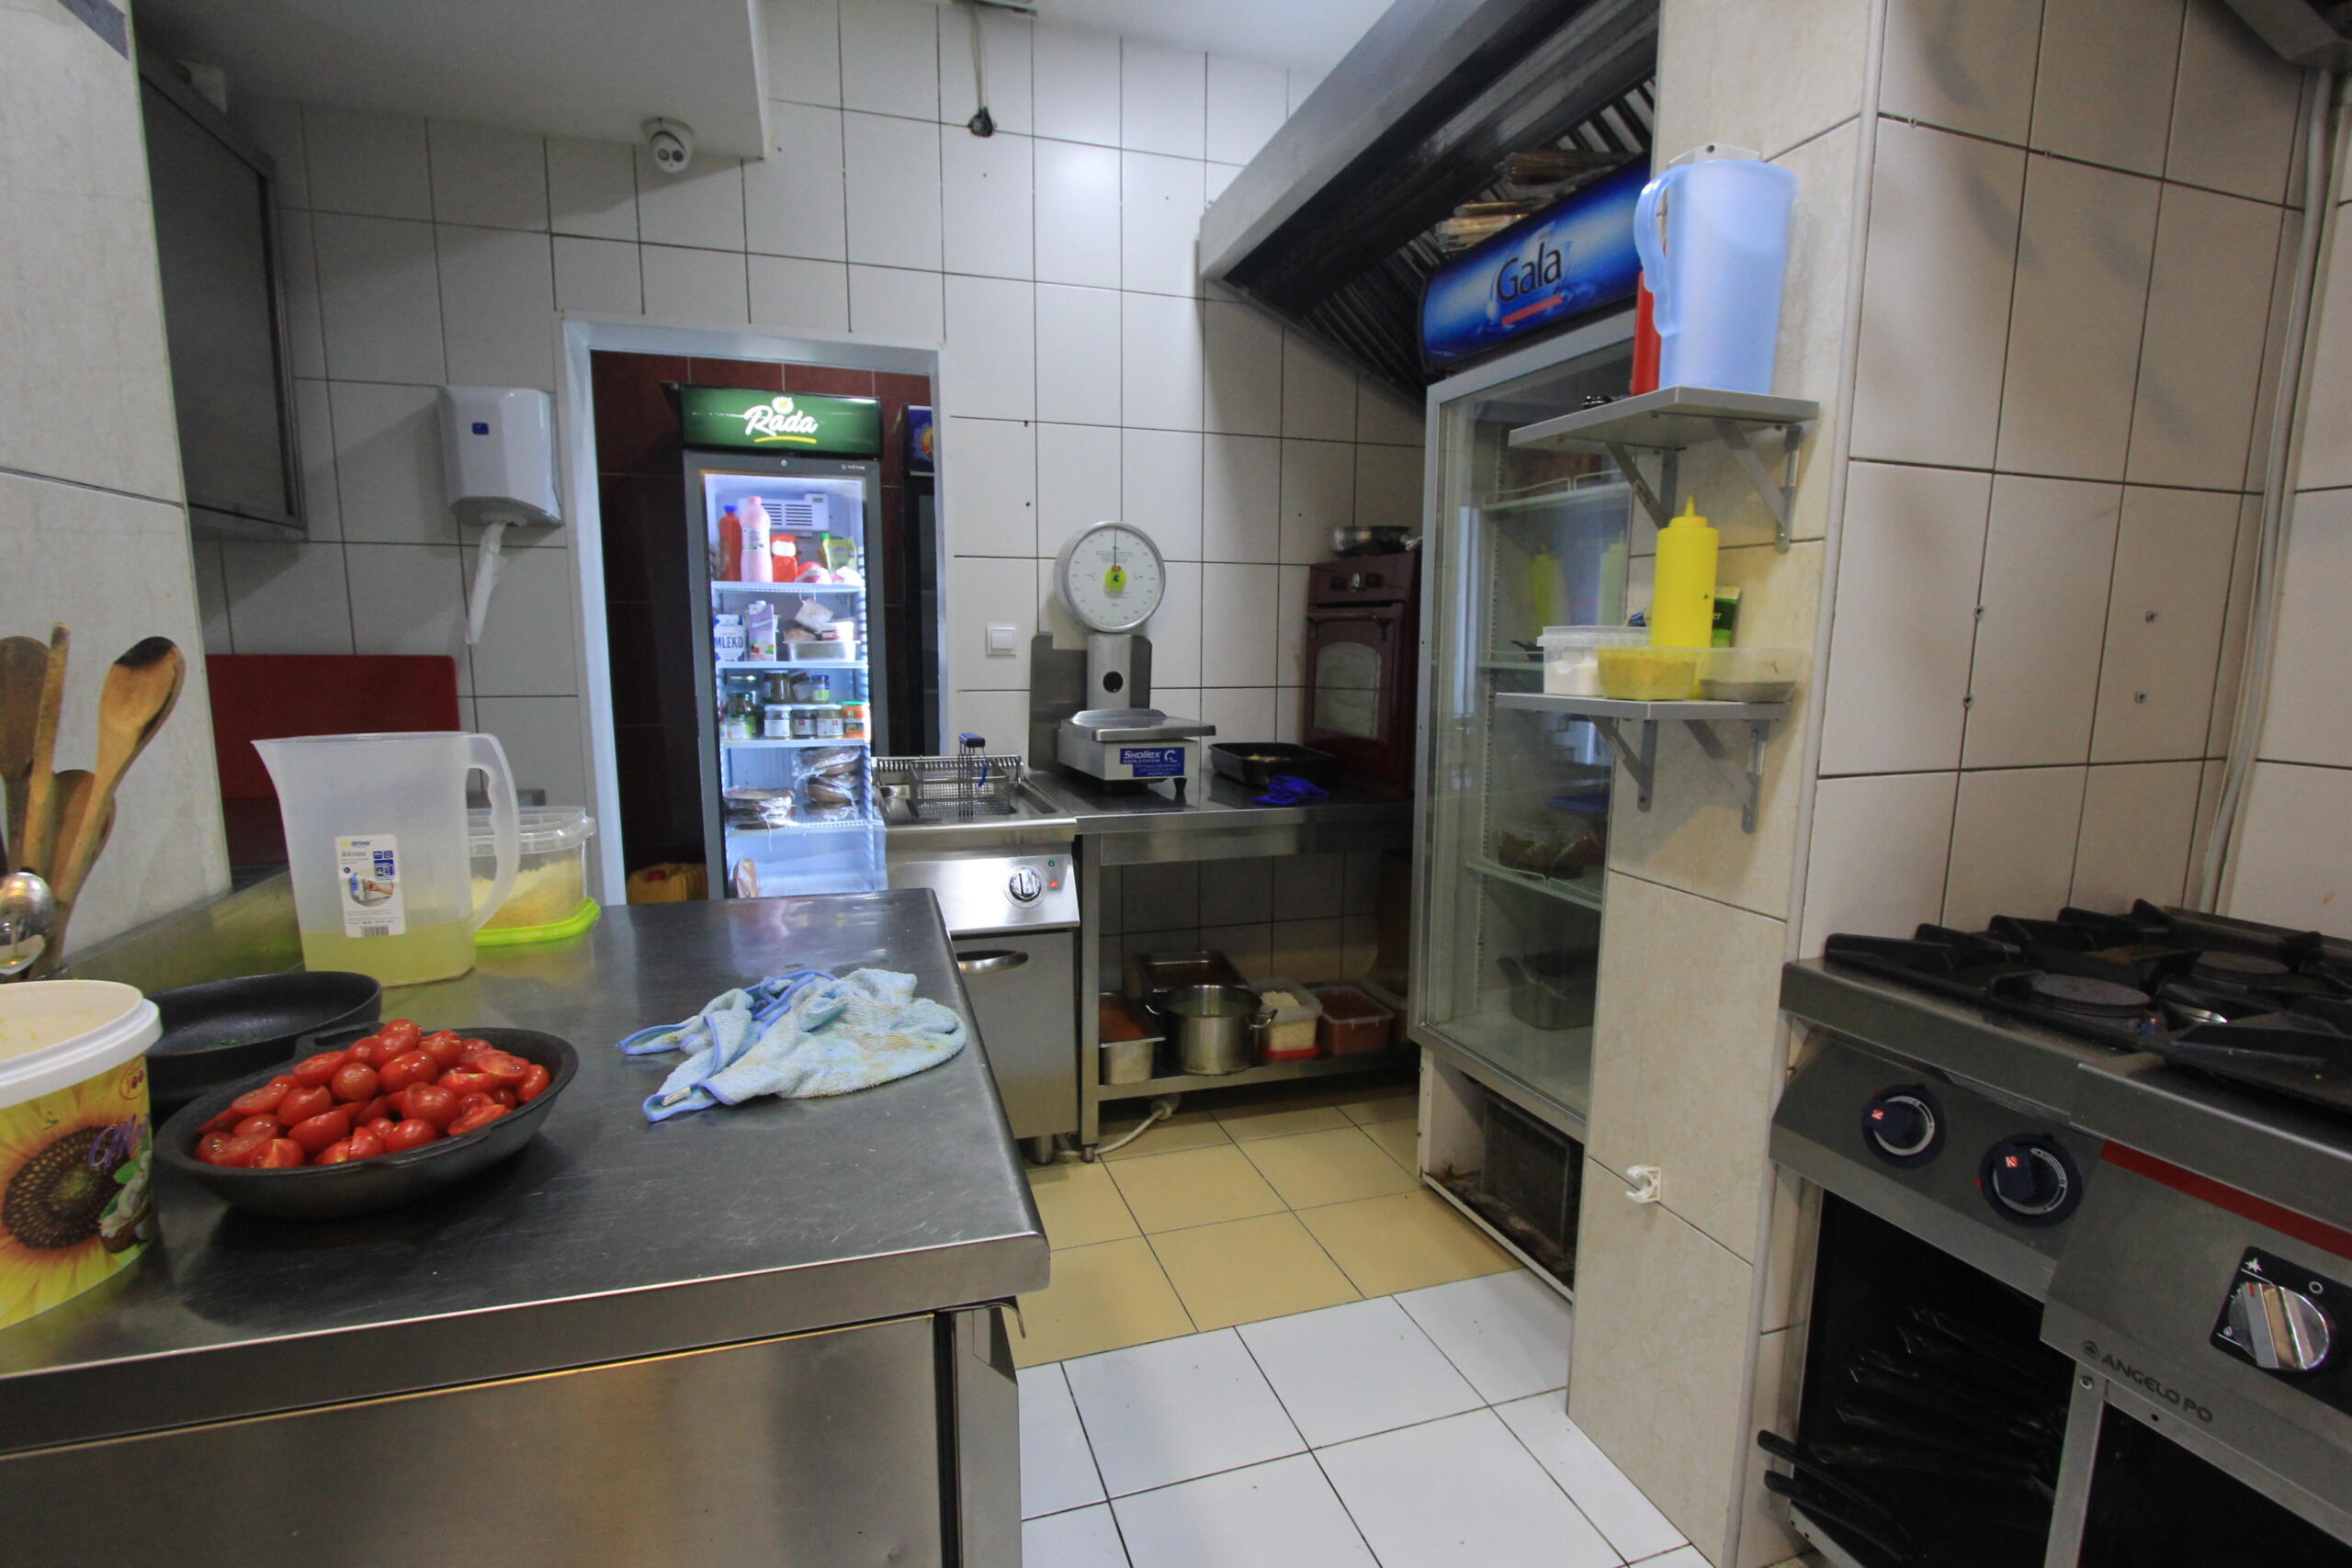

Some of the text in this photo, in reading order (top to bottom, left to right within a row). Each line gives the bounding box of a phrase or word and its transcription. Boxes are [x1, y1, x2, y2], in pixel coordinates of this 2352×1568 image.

[1497, 242, 1561, 302] Gala
[743, 404, 819, 436] Rada
[714, 636, 743, 649] MLEKO
[2101, 1353, 2213, 1423] ANGELO PO
